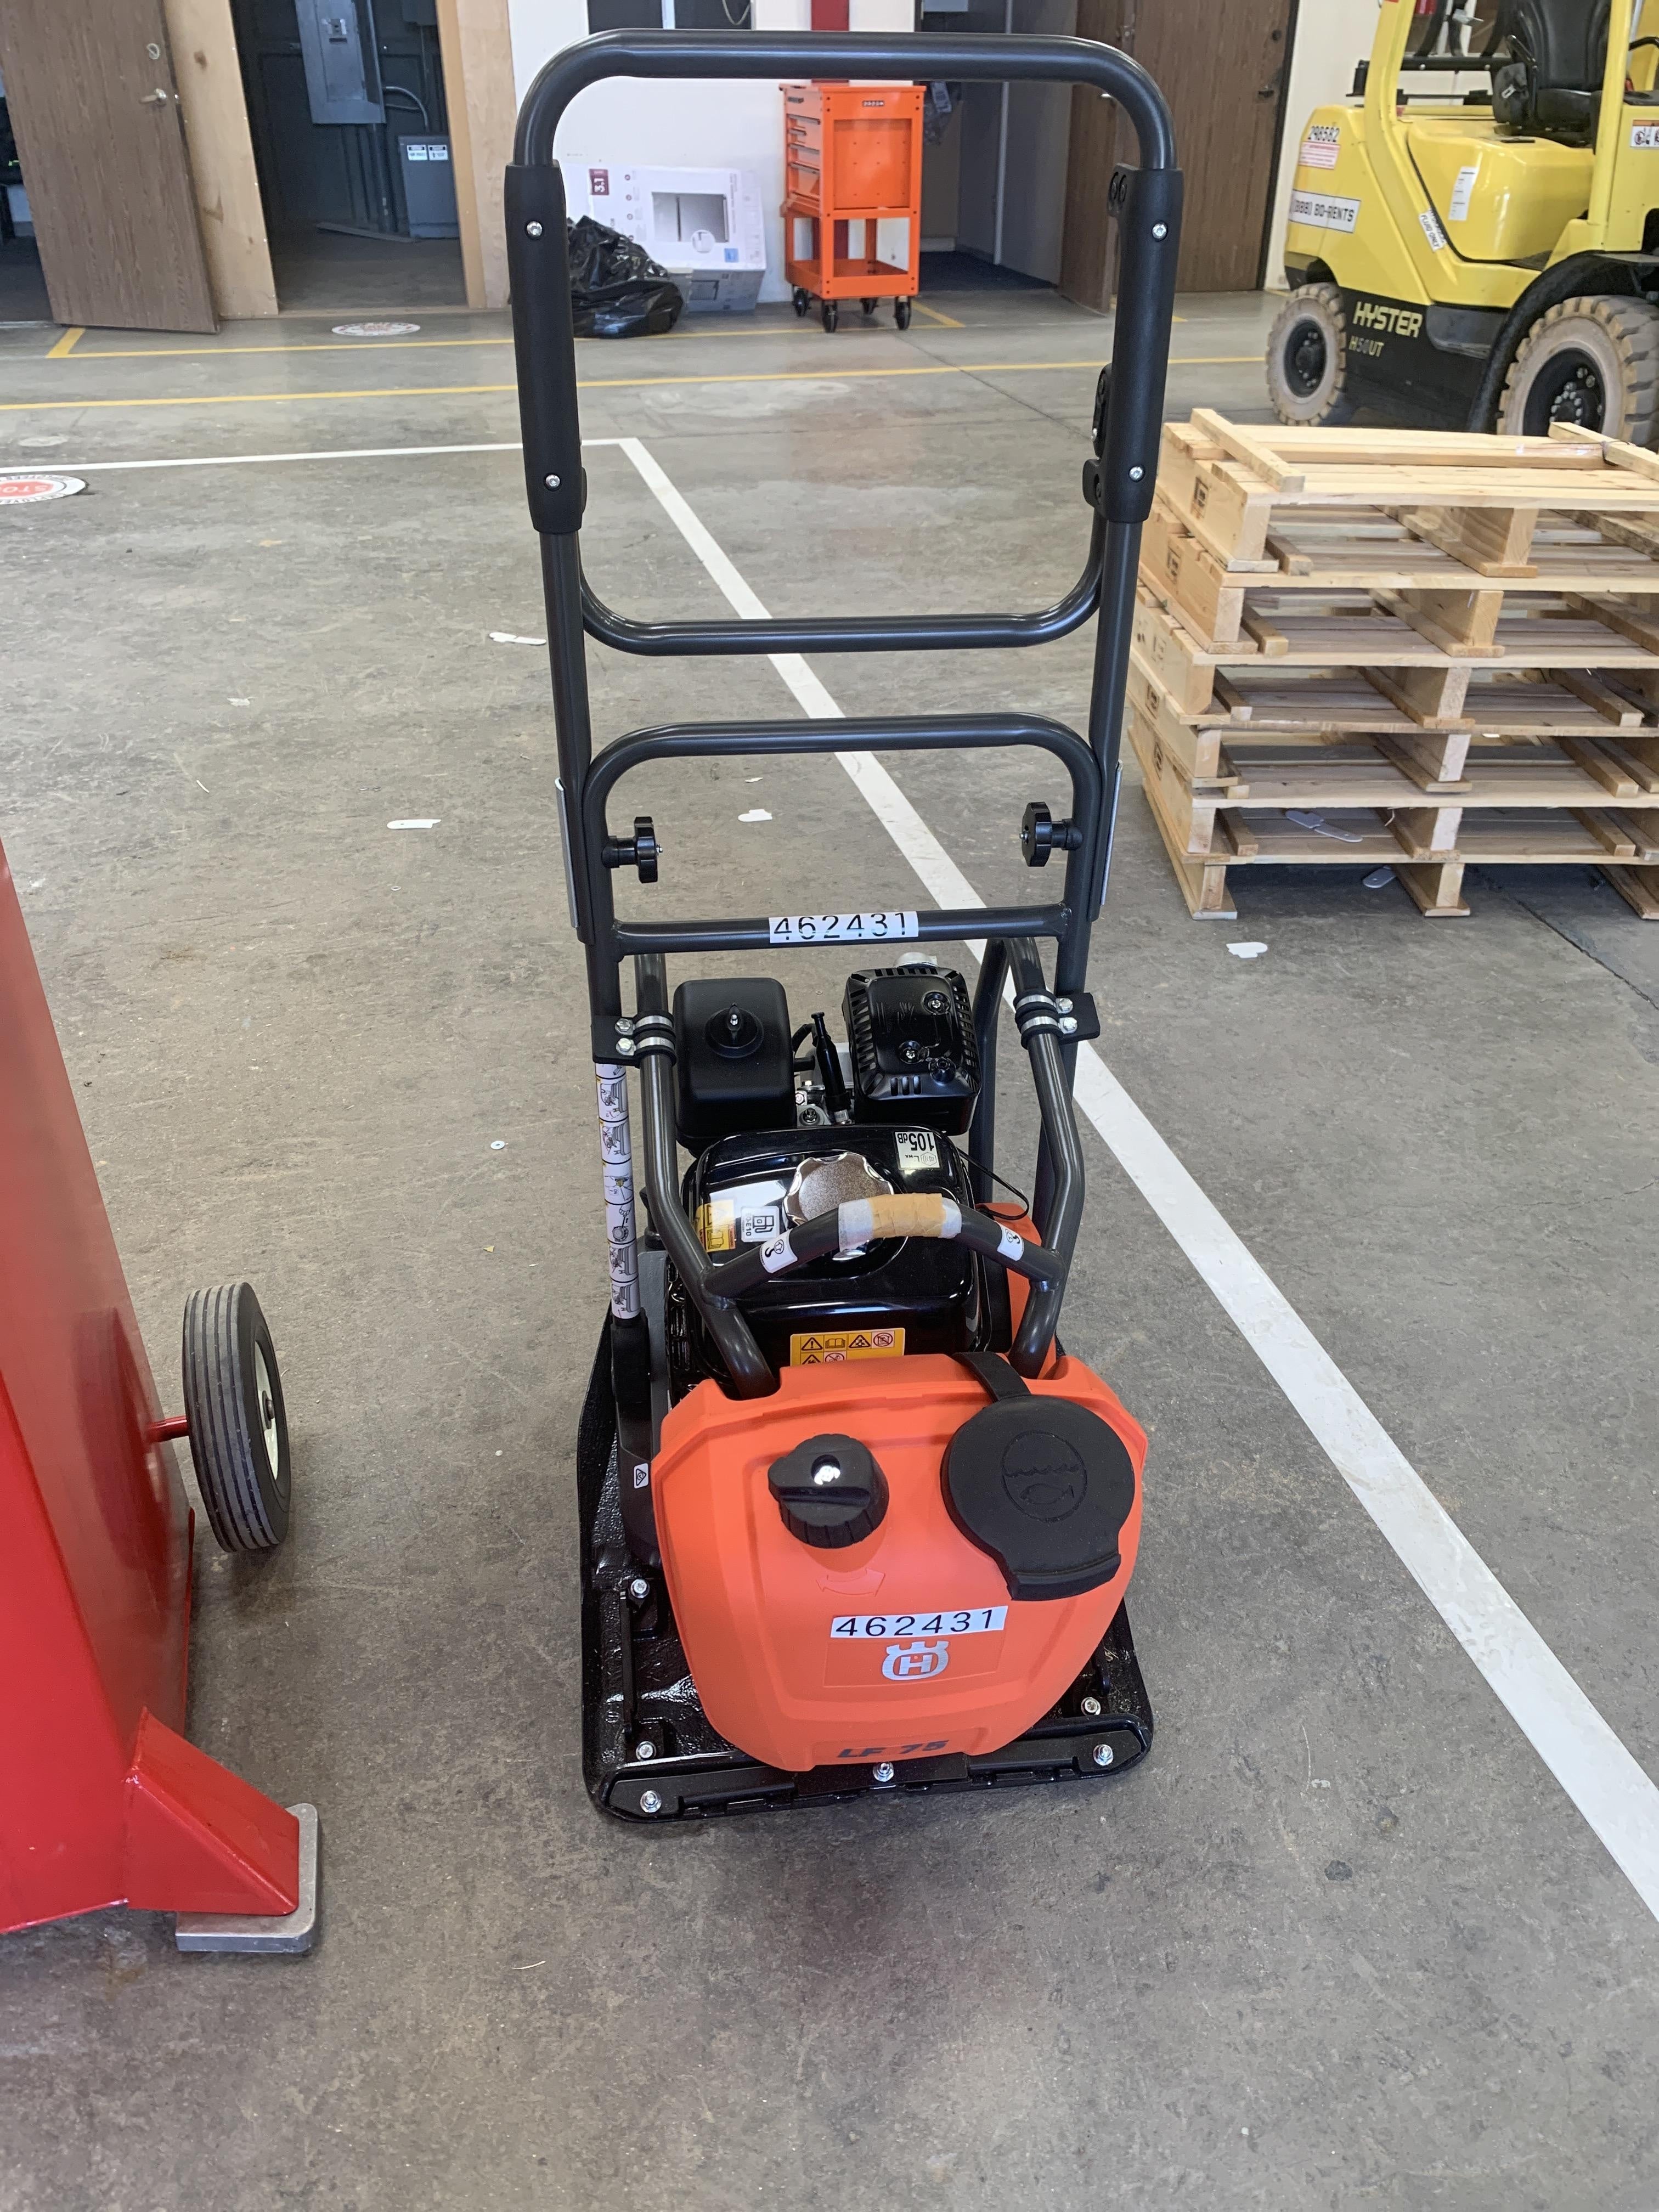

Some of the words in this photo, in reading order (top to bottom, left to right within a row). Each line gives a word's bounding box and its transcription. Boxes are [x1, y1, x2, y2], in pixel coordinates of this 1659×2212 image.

[1352, 301, 1423, 338] HYSTER
[0, 485, 48, 493] STO
[774, 912, 906, 940] 462431
[836, 1609, 992, 1636] 462431
[837, 1747, 886, 1758] LF
[899, 1739, 950, 1754] 75
